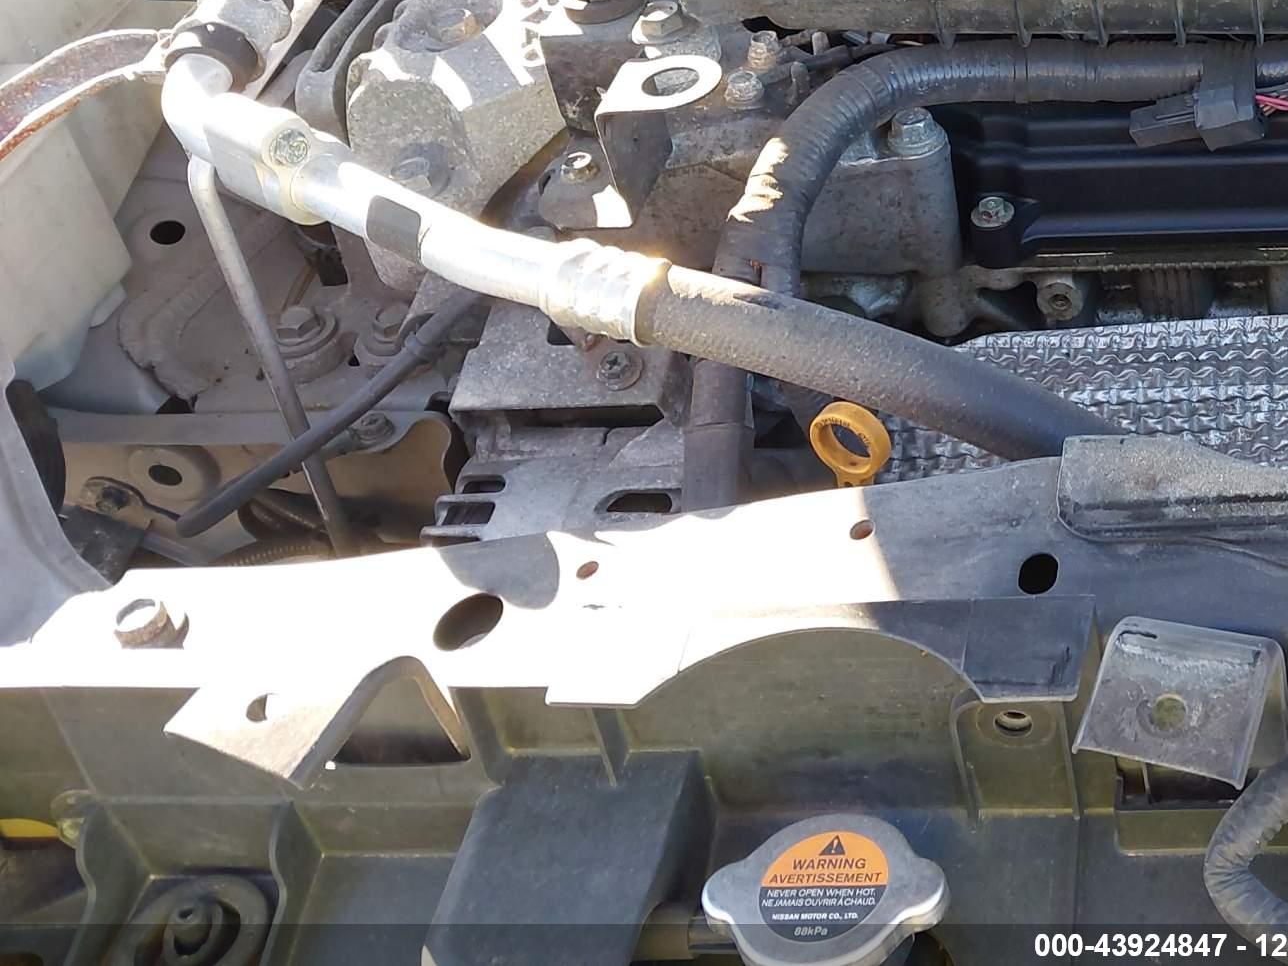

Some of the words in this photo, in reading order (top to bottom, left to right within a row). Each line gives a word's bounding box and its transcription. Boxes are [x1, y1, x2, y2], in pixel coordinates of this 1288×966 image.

[792, 858, 866, 871] WARNING
[769, 872, 882, 884] AVERTISSEMENT
[767, 889, 797, 898] NEVER
[798, 889, 824, 897] OPEN
[825, 888, 855, 897] WHEN
[761, 898, 774, 907] NE
[774, 898, 804, 907] JAMAIS
[806, 897, 838, 907] OUVRIR
[771, 912, 800, 920] NISSAN
[800, 912, 827, 920] MOTOR
[794, 926, 829, 936] 88kPa
